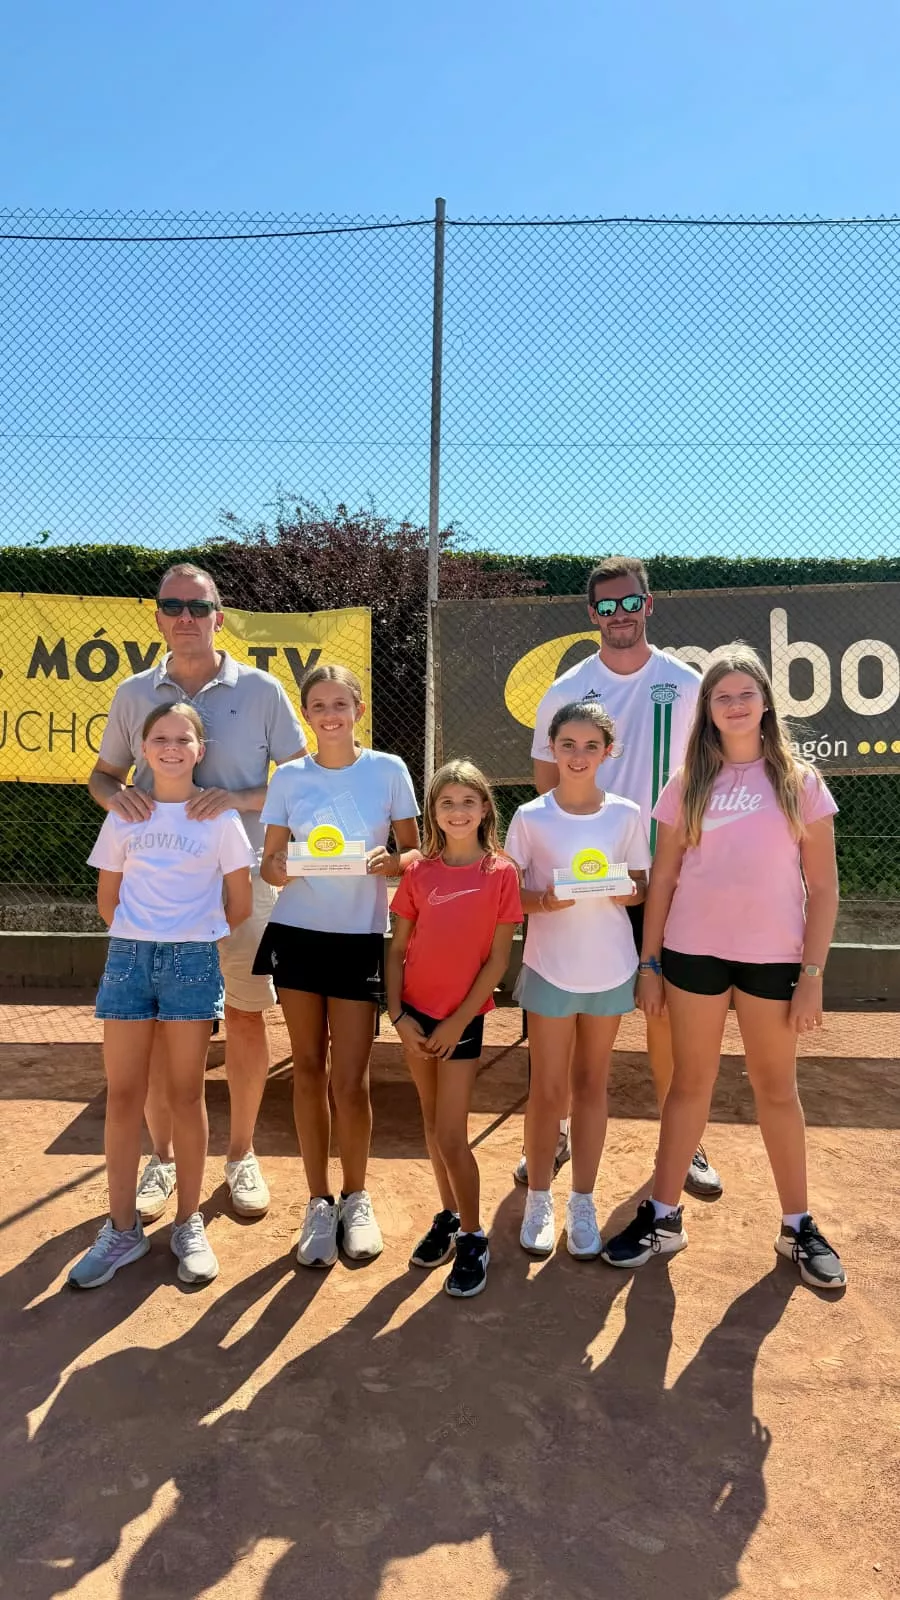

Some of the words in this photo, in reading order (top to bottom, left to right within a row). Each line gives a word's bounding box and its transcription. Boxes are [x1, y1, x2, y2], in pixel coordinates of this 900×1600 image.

[26, 628, 168, 682] MÓV
[789, 734, 848, 763] agón
[709, 785, 763, 811] nike
